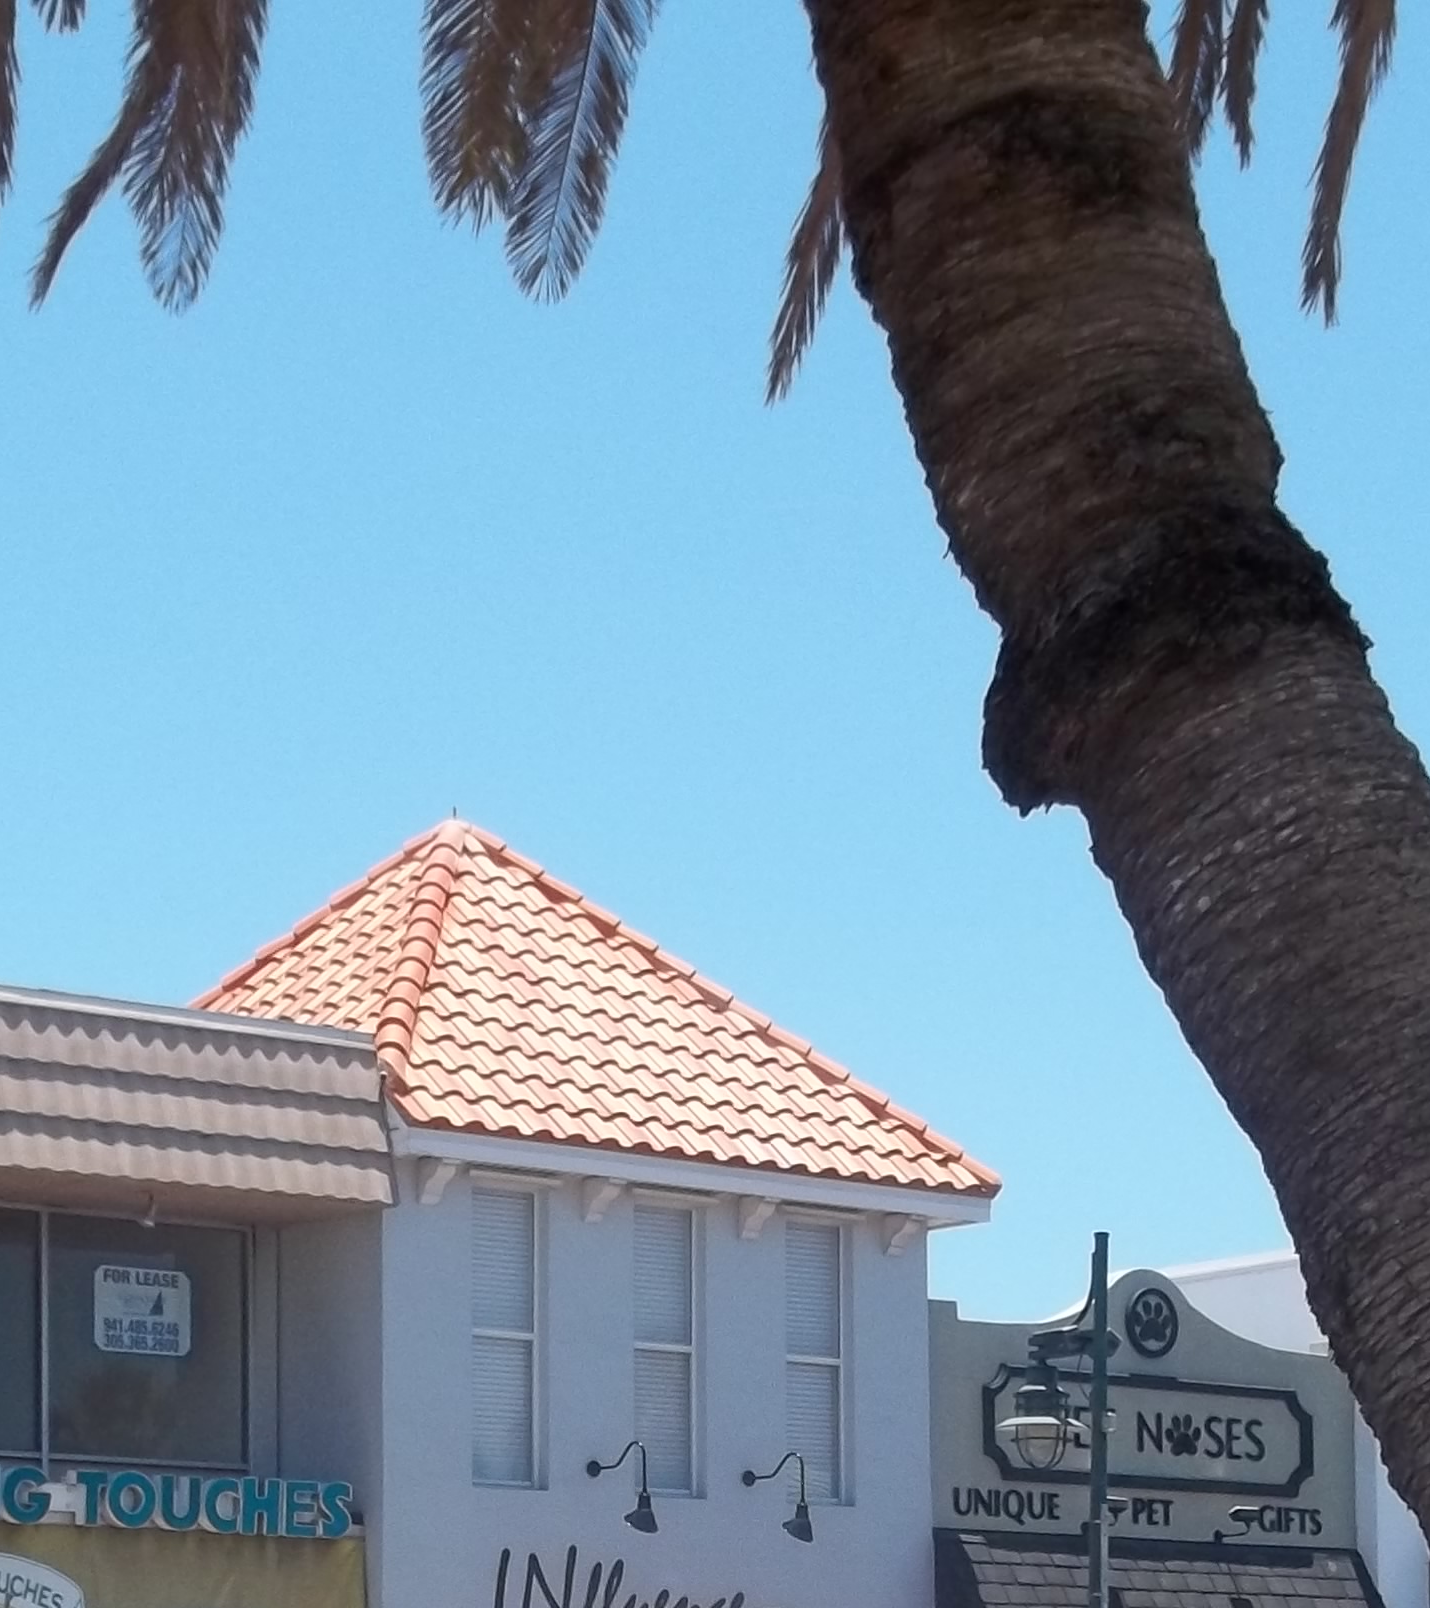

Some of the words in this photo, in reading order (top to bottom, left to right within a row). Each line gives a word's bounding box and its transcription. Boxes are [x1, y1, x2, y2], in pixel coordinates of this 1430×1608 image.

[103, 1268, 131, 1285] FOR
[135, 1270, 180, 1289] LEASE
[73, 1470, 355, 1539] TOUCHES
[953, 1487, 1061, 1526] UNIQUE
[1130, 1498, 1173, 1527] PET
[1258, 1504, 1324, 1537] GIFTS
